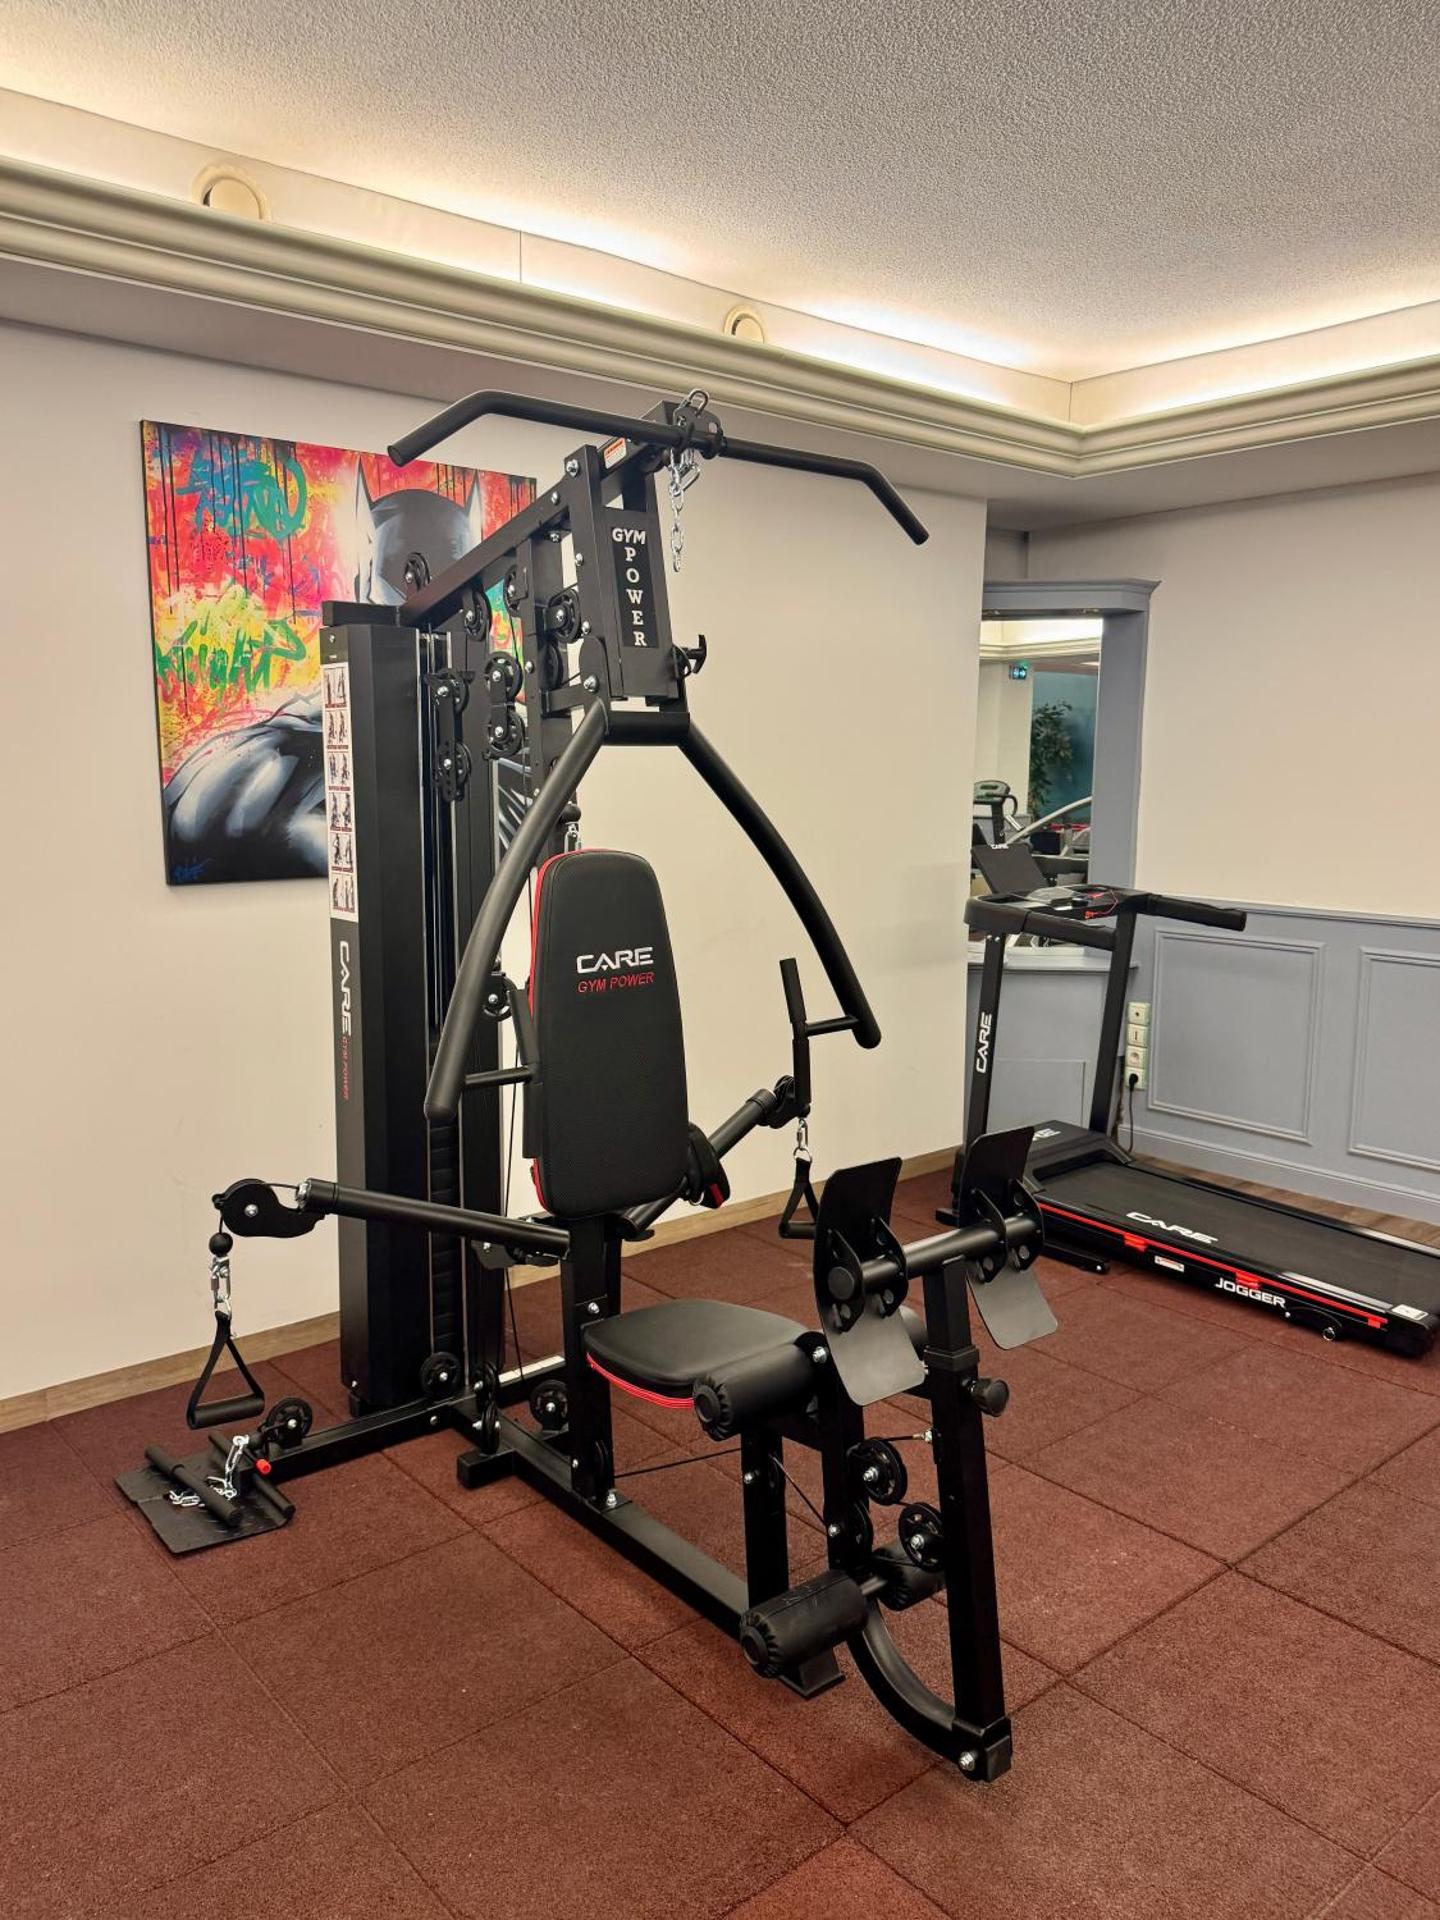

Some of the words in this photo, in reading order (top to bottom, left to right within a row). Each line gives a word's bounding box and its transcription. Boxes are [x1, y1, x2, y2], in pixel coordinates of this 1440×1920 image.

[612, 528, 646, 545] GYM
[625, 547, 647, 647] POWER
[576, 946, 654, 974] CARE
[339, 940, 352, 1037] CARE
[578, 978, 607, 993] GYM
[610, 971, 655, 990] POWER
[976, 1011, 992, 1073] CARE
[1126, 1211, 1218, 1244] CARE
[1215, 1277, 1286, 1308] JOGGER
